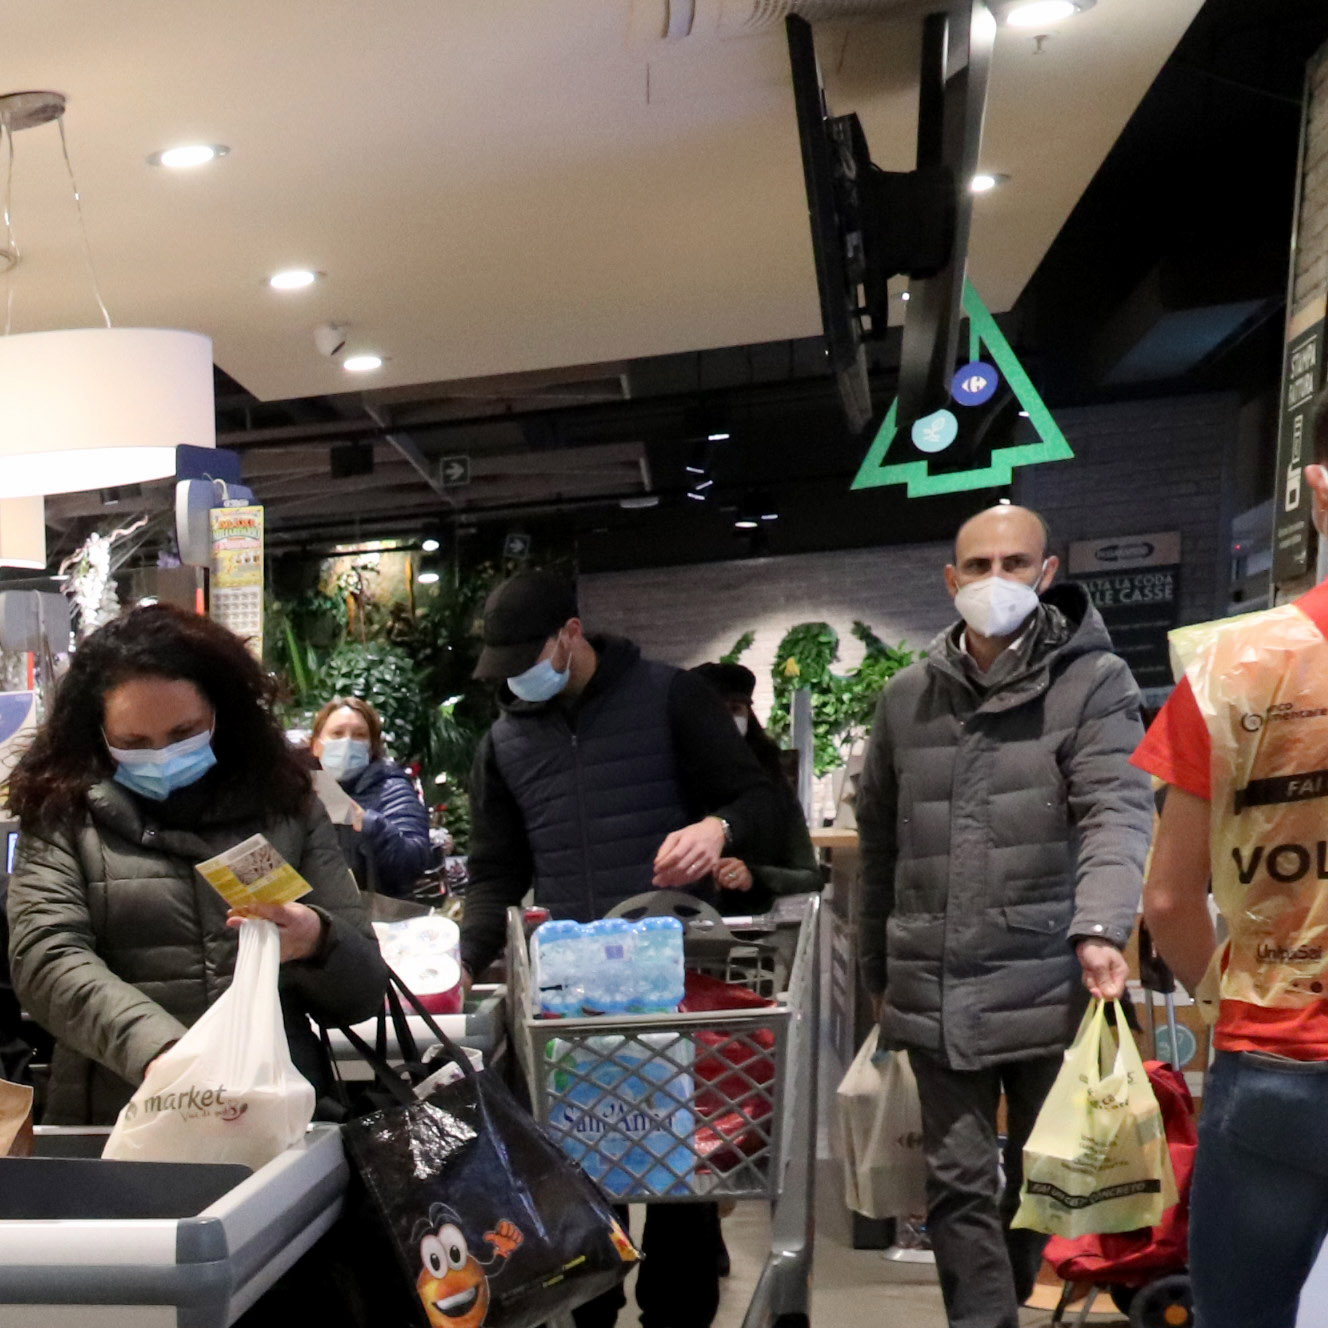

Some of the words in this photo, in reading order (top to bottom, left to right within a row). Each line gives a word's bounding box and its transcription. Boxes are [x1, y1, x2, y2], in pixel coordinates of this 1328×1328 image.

[1134, 574, 1174, 588] CODA
[1120, 585, 1174, 603] CASSE
[1287, 777, 1322, 797] FAI
[144, 1083, 228, 1114] market
